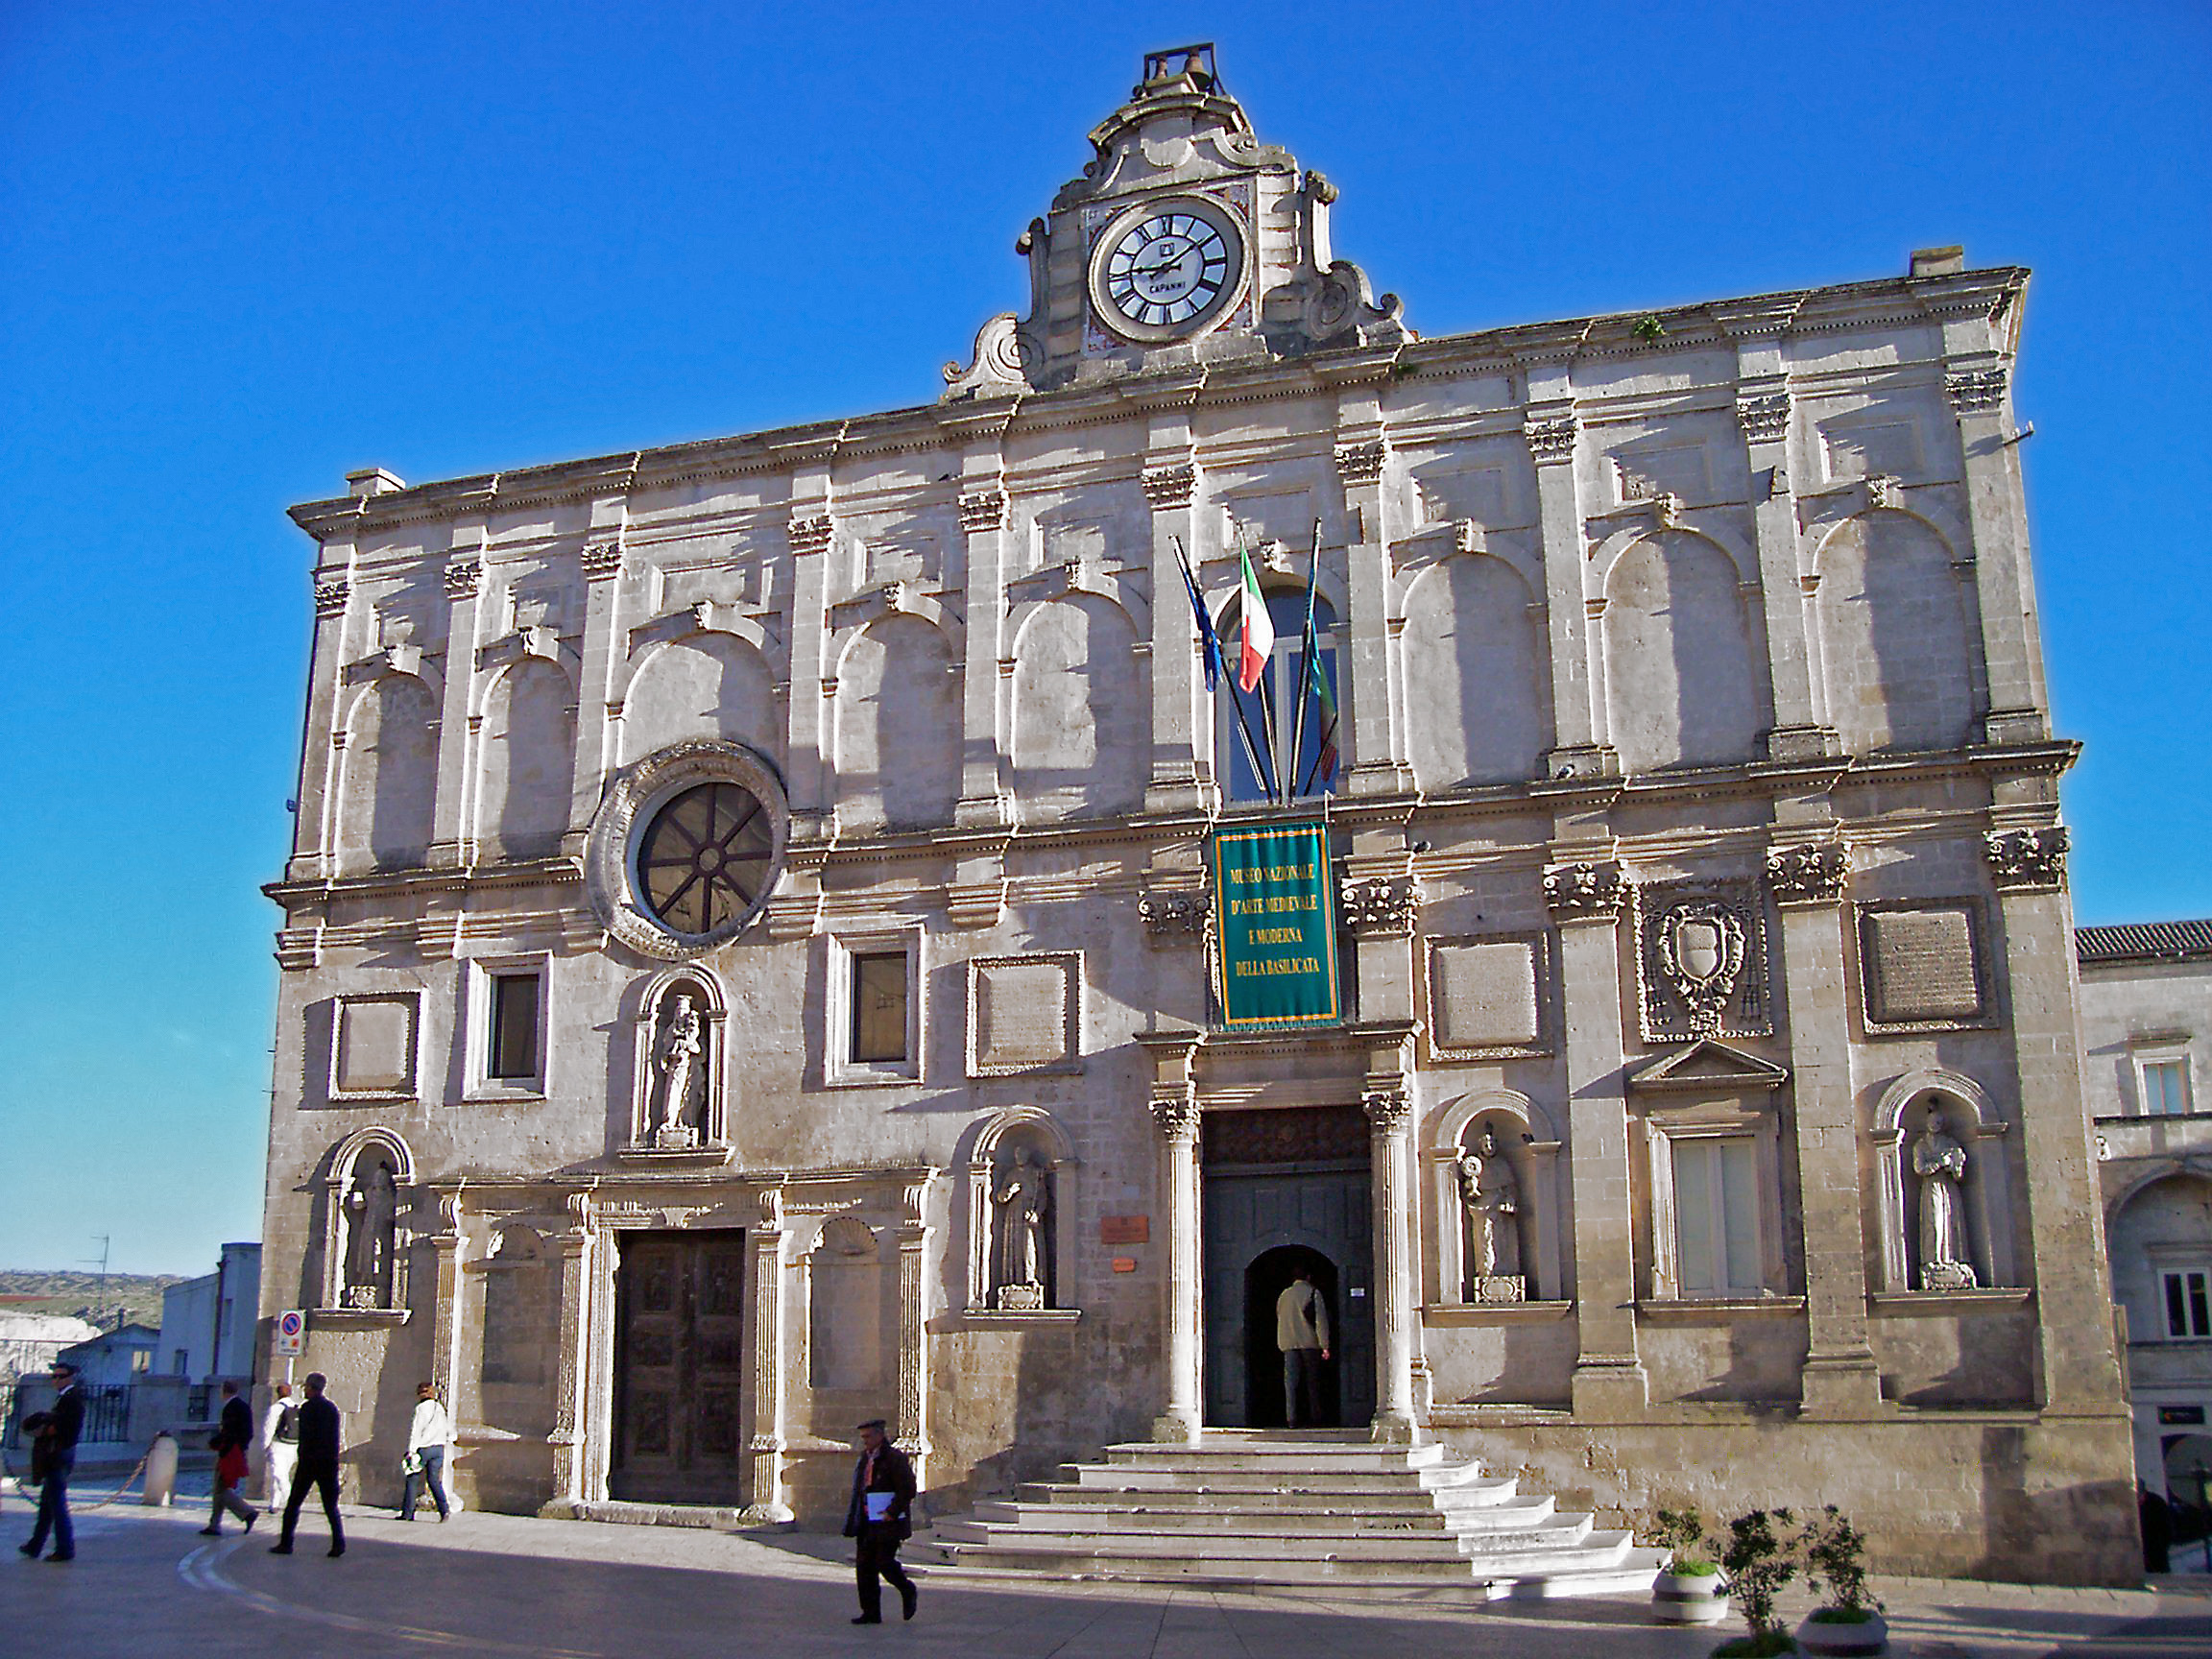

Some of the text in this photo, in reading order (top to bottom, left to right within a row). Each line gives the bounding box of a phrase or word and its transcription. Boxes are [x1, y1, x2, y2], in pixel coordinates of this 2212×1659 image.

[1230, 864, 1315, 883] MUSEO NAZIONALE
[1232, 895, 1317, 915] D'ARTE MEDIEVALE
[1249, 927, 1303, 945] E MODERNA
[1237, 957, 1320, 976] DELLA BASILICATA
